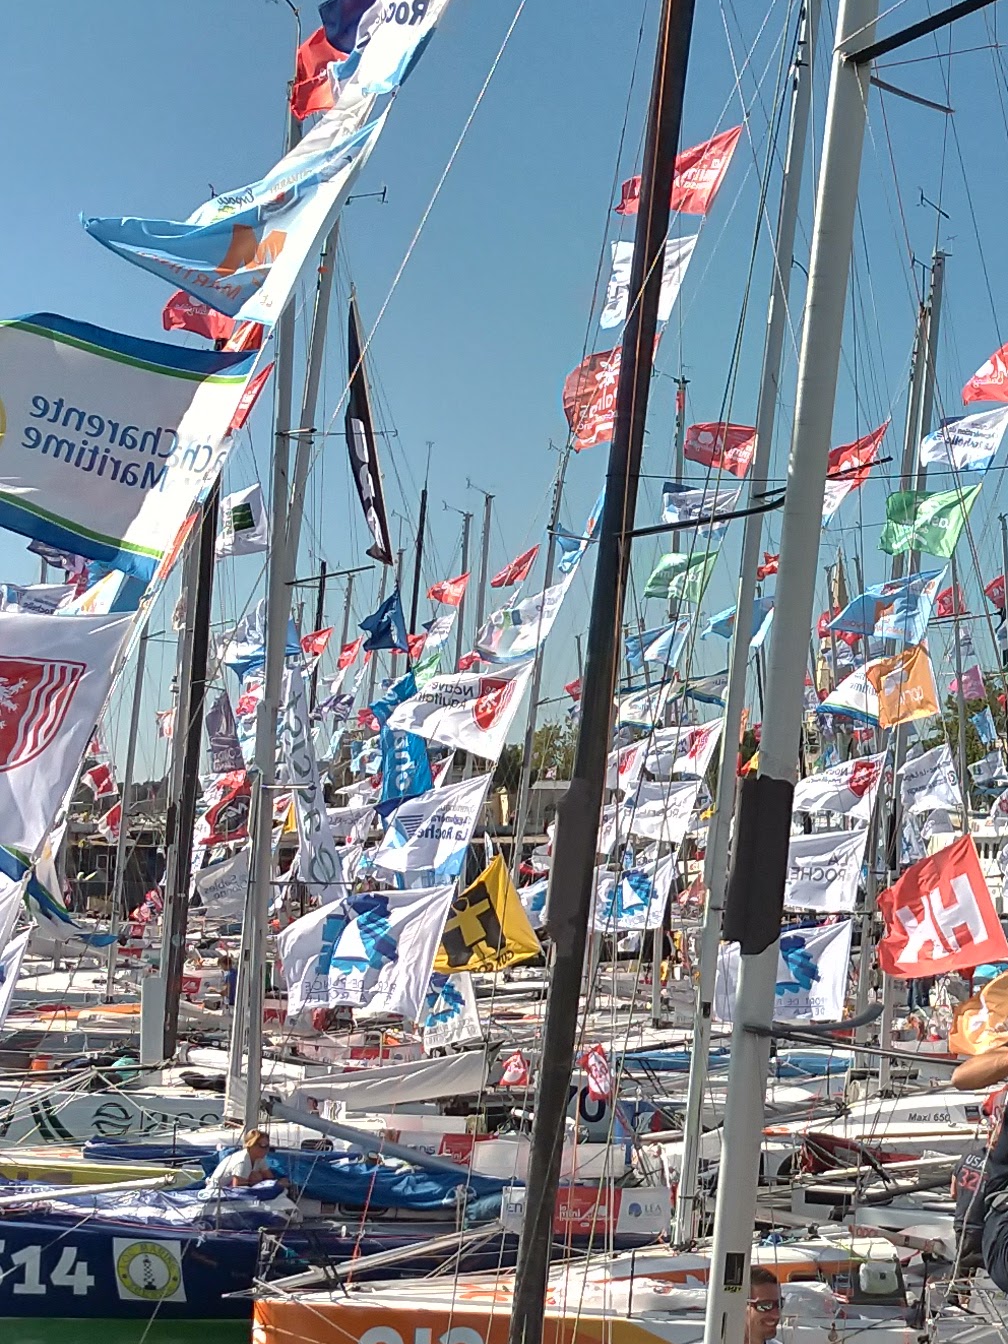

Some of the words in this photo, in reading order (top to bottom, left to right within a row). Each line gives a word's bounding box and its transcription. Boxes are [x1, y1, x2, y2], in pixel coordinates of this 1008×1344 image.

[907, 1112, 932, 1122] Maxi
[933, 1112, 951, 1123] 650
[965, 1154, 988, 1169] USA
[0, 1238, 95, 1296] 14
